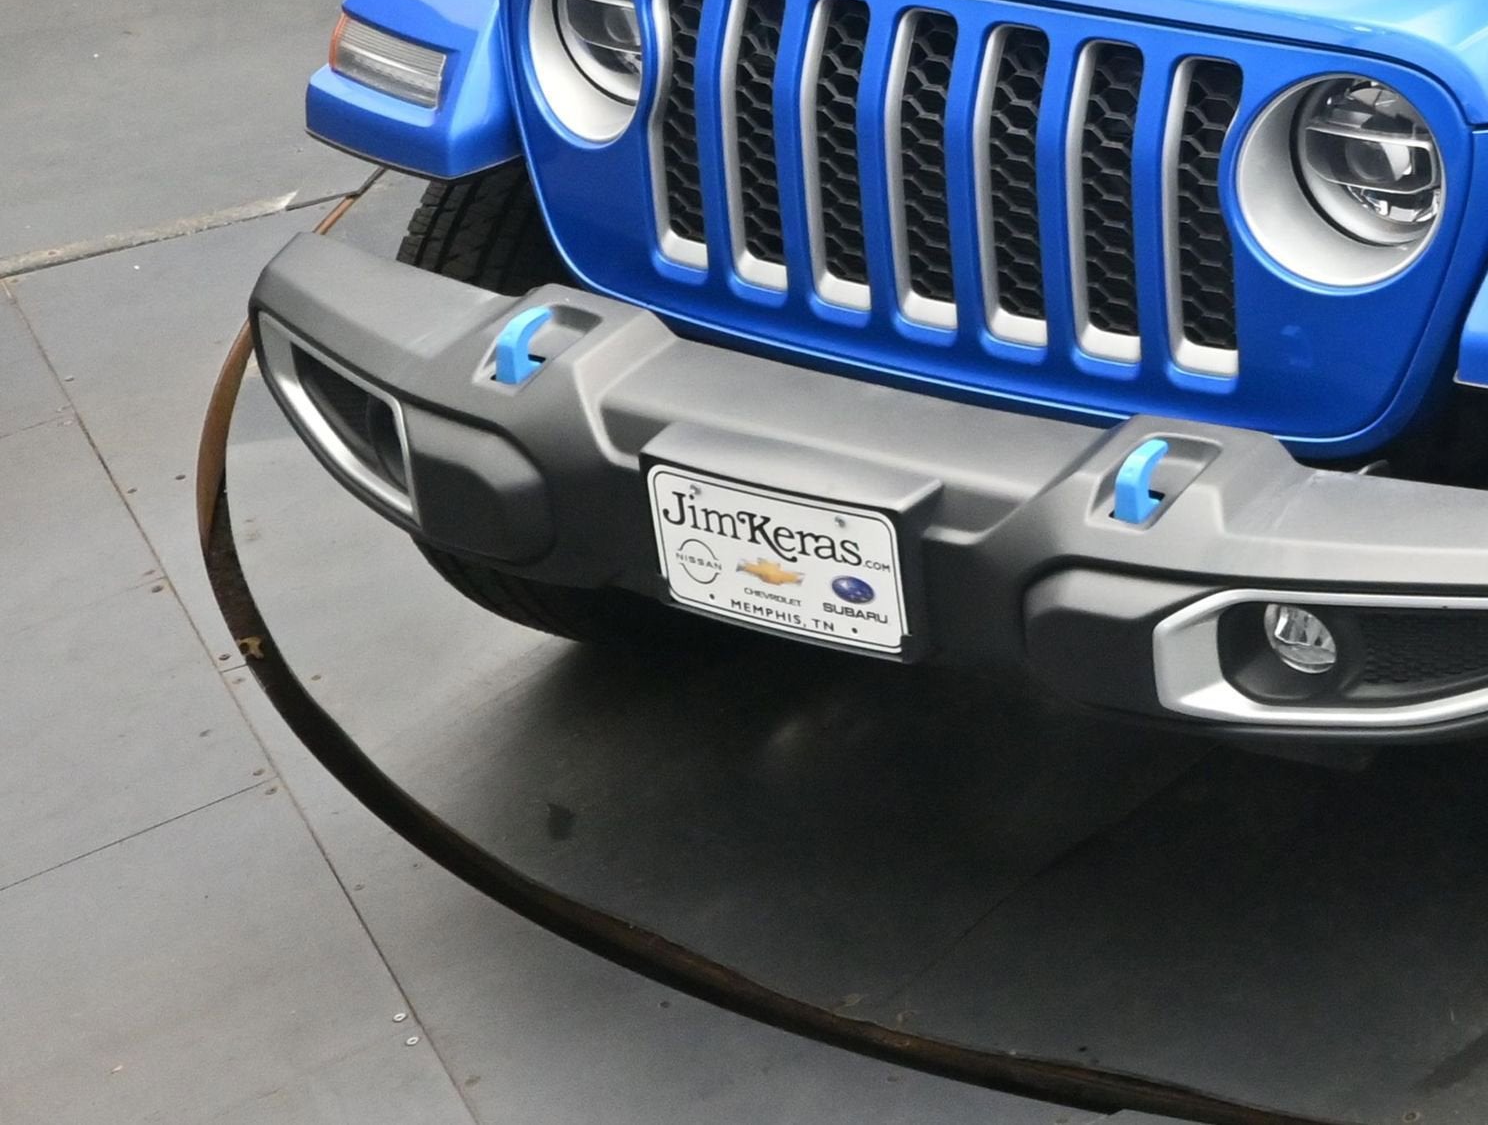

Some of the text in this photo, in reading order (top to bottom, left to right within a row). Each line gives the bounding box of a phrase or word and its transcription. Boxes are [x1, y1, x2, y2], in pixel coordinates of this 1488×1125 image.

[676, 552, 722, 571] NISSAN
[744, 587, 802, 607] CHEVROLET
[823, 602, 888, 624] SUBARU
[812, 618, 834, 632] TN
